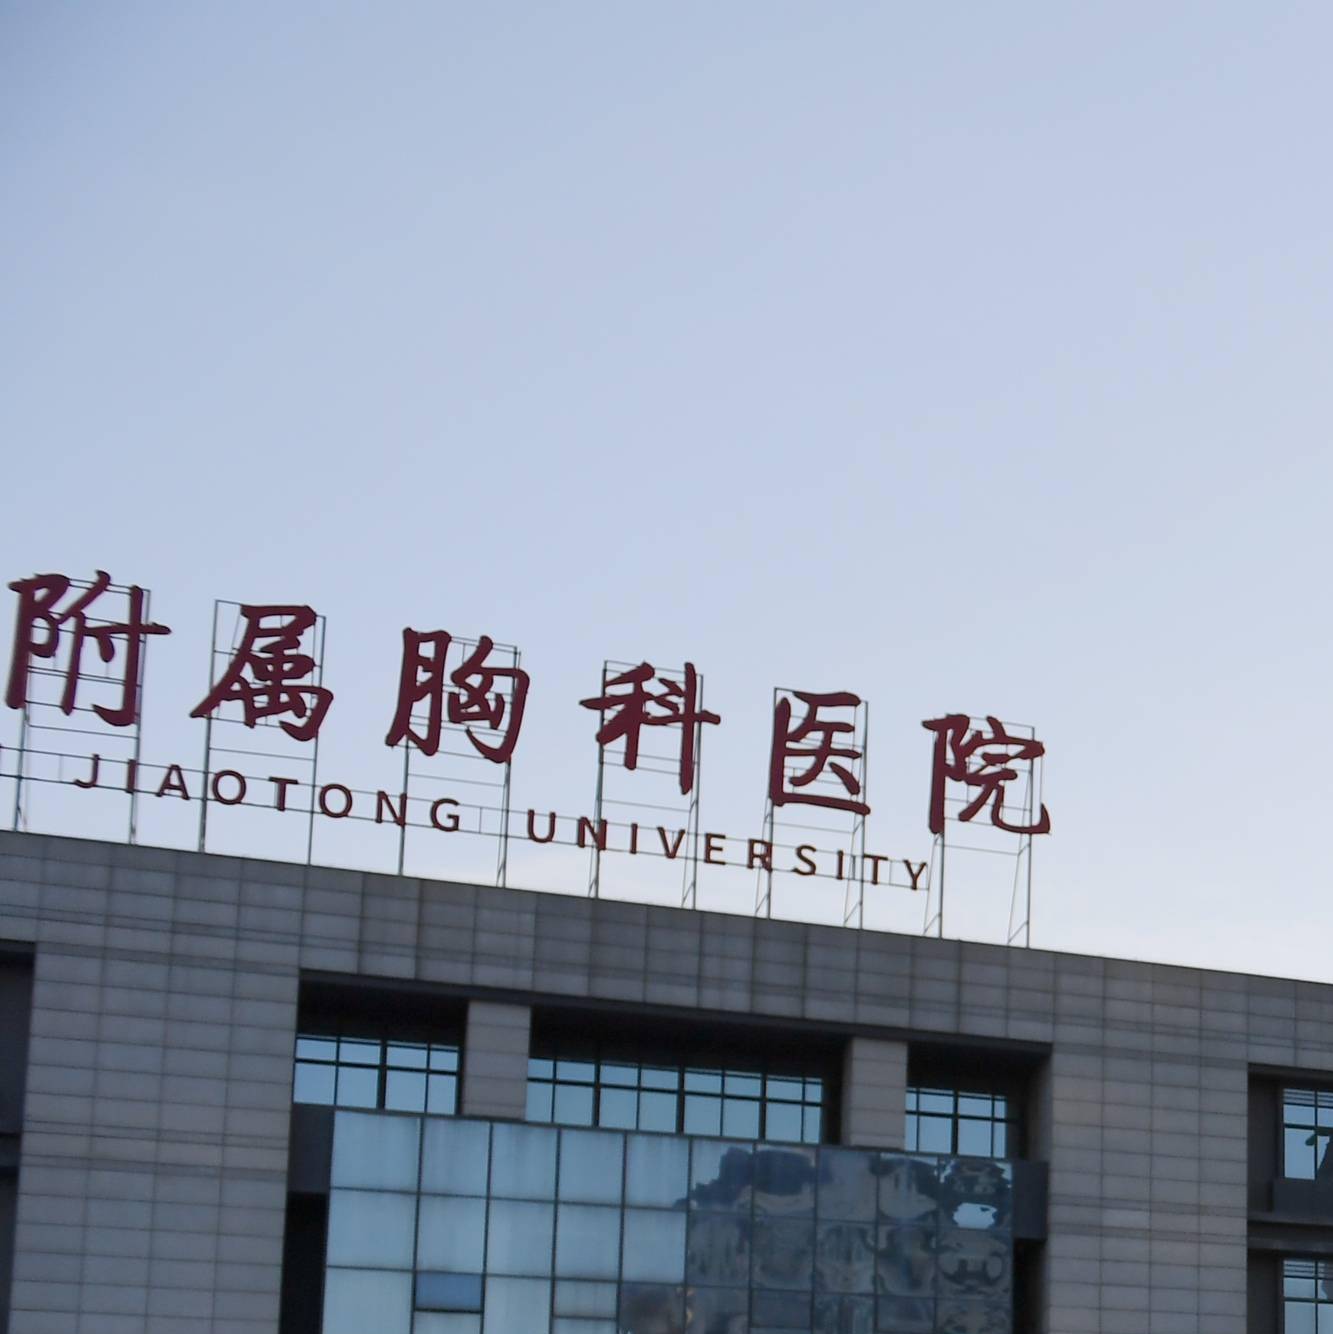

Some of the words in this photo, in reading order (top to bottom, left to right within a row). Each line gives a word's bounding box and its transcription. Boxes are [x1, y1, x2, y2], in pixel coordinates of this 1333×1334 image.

[4, 570, 1050, 836] 附属胸科医院
[73, 753, 461, 834] JIAOTONG
[526, 808, 930, 891] UNIVERSITY
